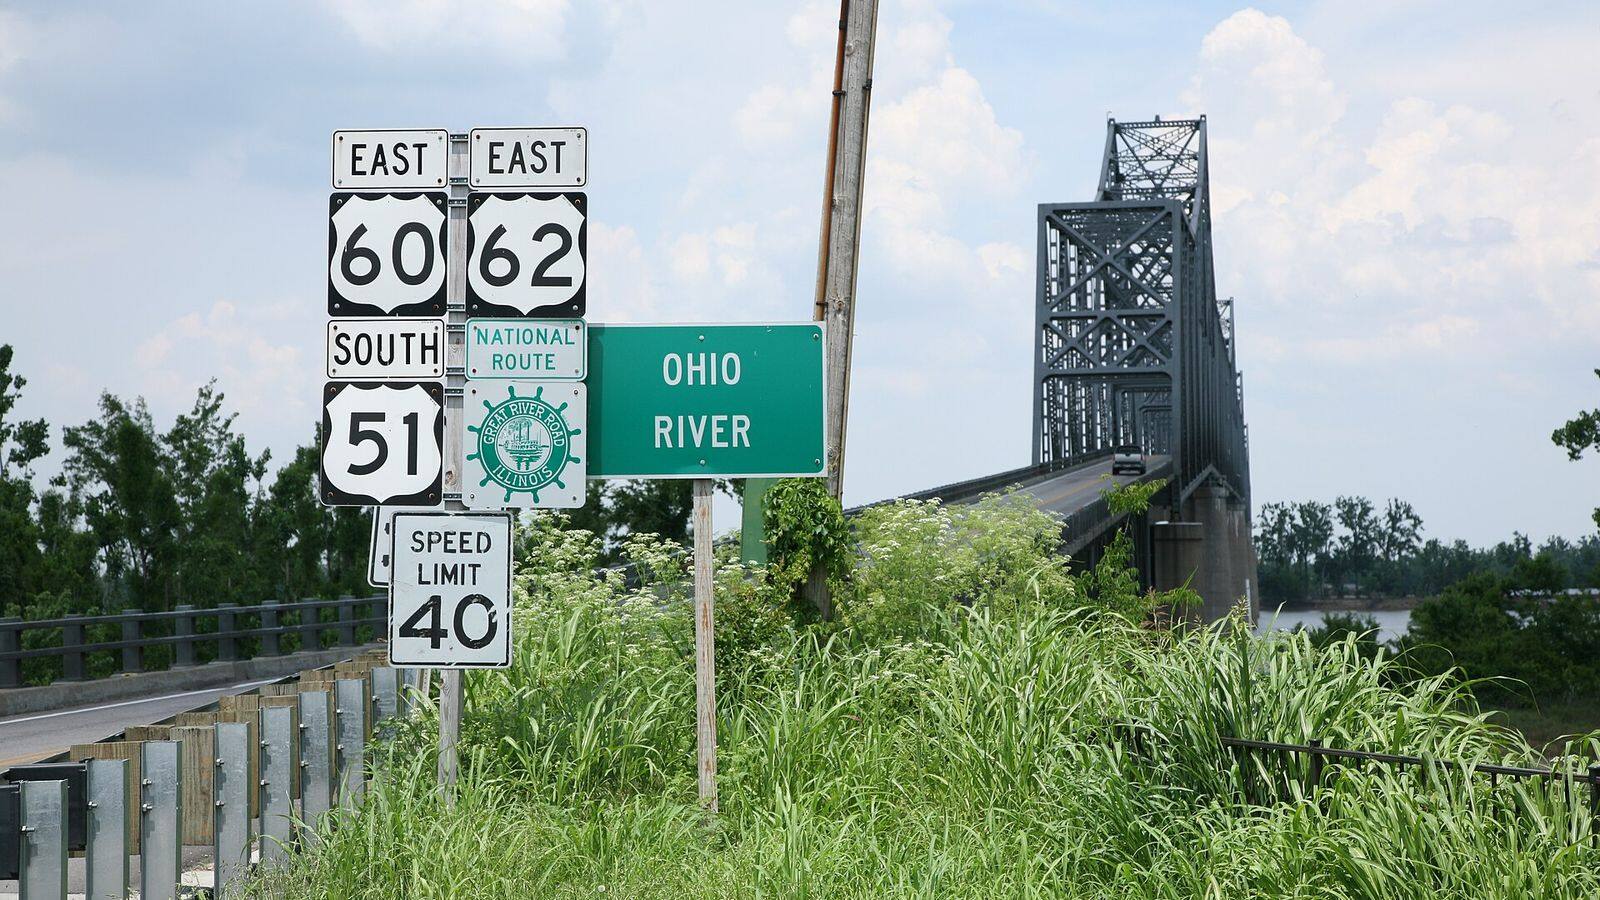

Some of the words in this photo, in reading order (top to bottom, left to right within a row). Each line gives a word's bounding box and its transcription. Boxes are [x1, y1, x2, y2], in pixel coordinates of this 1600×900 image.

[351, 143, 427, 175] EAST
[488, 141, 566, 174] EAST
[340, 221, 435, 286] 60
[479, 222, 573, 287] 62
[333, 332, 438, 366] SOUTH
[476, 328, 575, 346] NATIONAL
[491, 353, 556, 371] ROUTE
[662, 352, 741, 386] OHIO
[483, 408, 509, 445] GREAT
[508, 402, 546, 416] RIVER
[543, 413, 565, 447] ROAD
[654, 414, 751, 448] RIVER
[346, 412, 419, 476] 51
[492, 465, 553, 487] ILLINOIS
[410, 530, 492, 554] SPEED
[417, 563, 481, 585] LIMIT
[398, 593, 498, 650] 40
